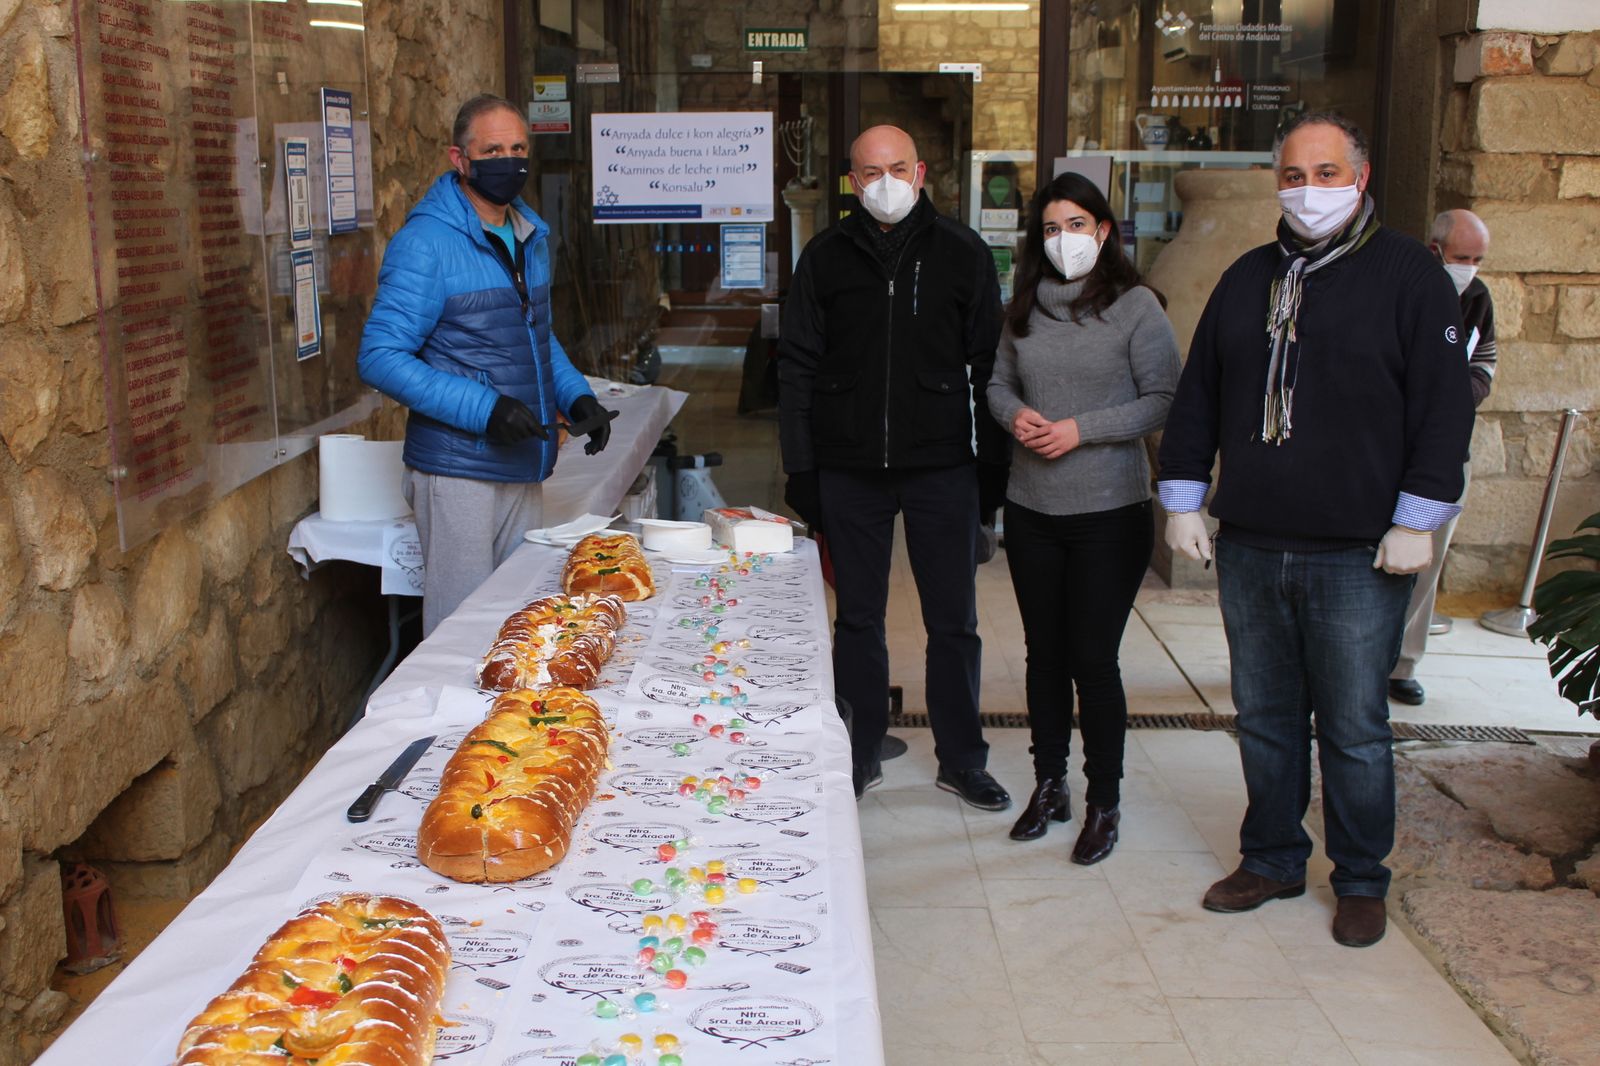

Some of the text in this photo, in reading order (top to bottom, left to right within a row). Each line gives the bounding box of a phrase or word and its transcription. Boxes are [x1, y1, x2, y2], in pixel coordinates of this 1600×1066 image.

[1236, 22, 1266, 32] Ciudades
[1268, 22, 1293, 32] Medias
[748, 32, 805, 47] ENTRADA
[1199, 32, 1210, 41] del
[1211, 32, 1234, 41] Centro
[1235, 32, 1245, 41] de
[1151, 85, 1242, 94] Ayuntamiento de Lucena
[655, 128, 683, 140] dulce
[686, 129, 690, 139] i
[693, 128, 713, 139] kon
[670, 146, 702, 157] buena
[705, 146, 709, 156] i
[668, 164, 681, 175] de
[684, 163, 712, 175] leche
[716, 164, 720, 174] i
[671, 683, 687, 692] Ntra.
[602, 972, 645, 980] Araceli
[756, 1018, 801, 1026] Araceli
